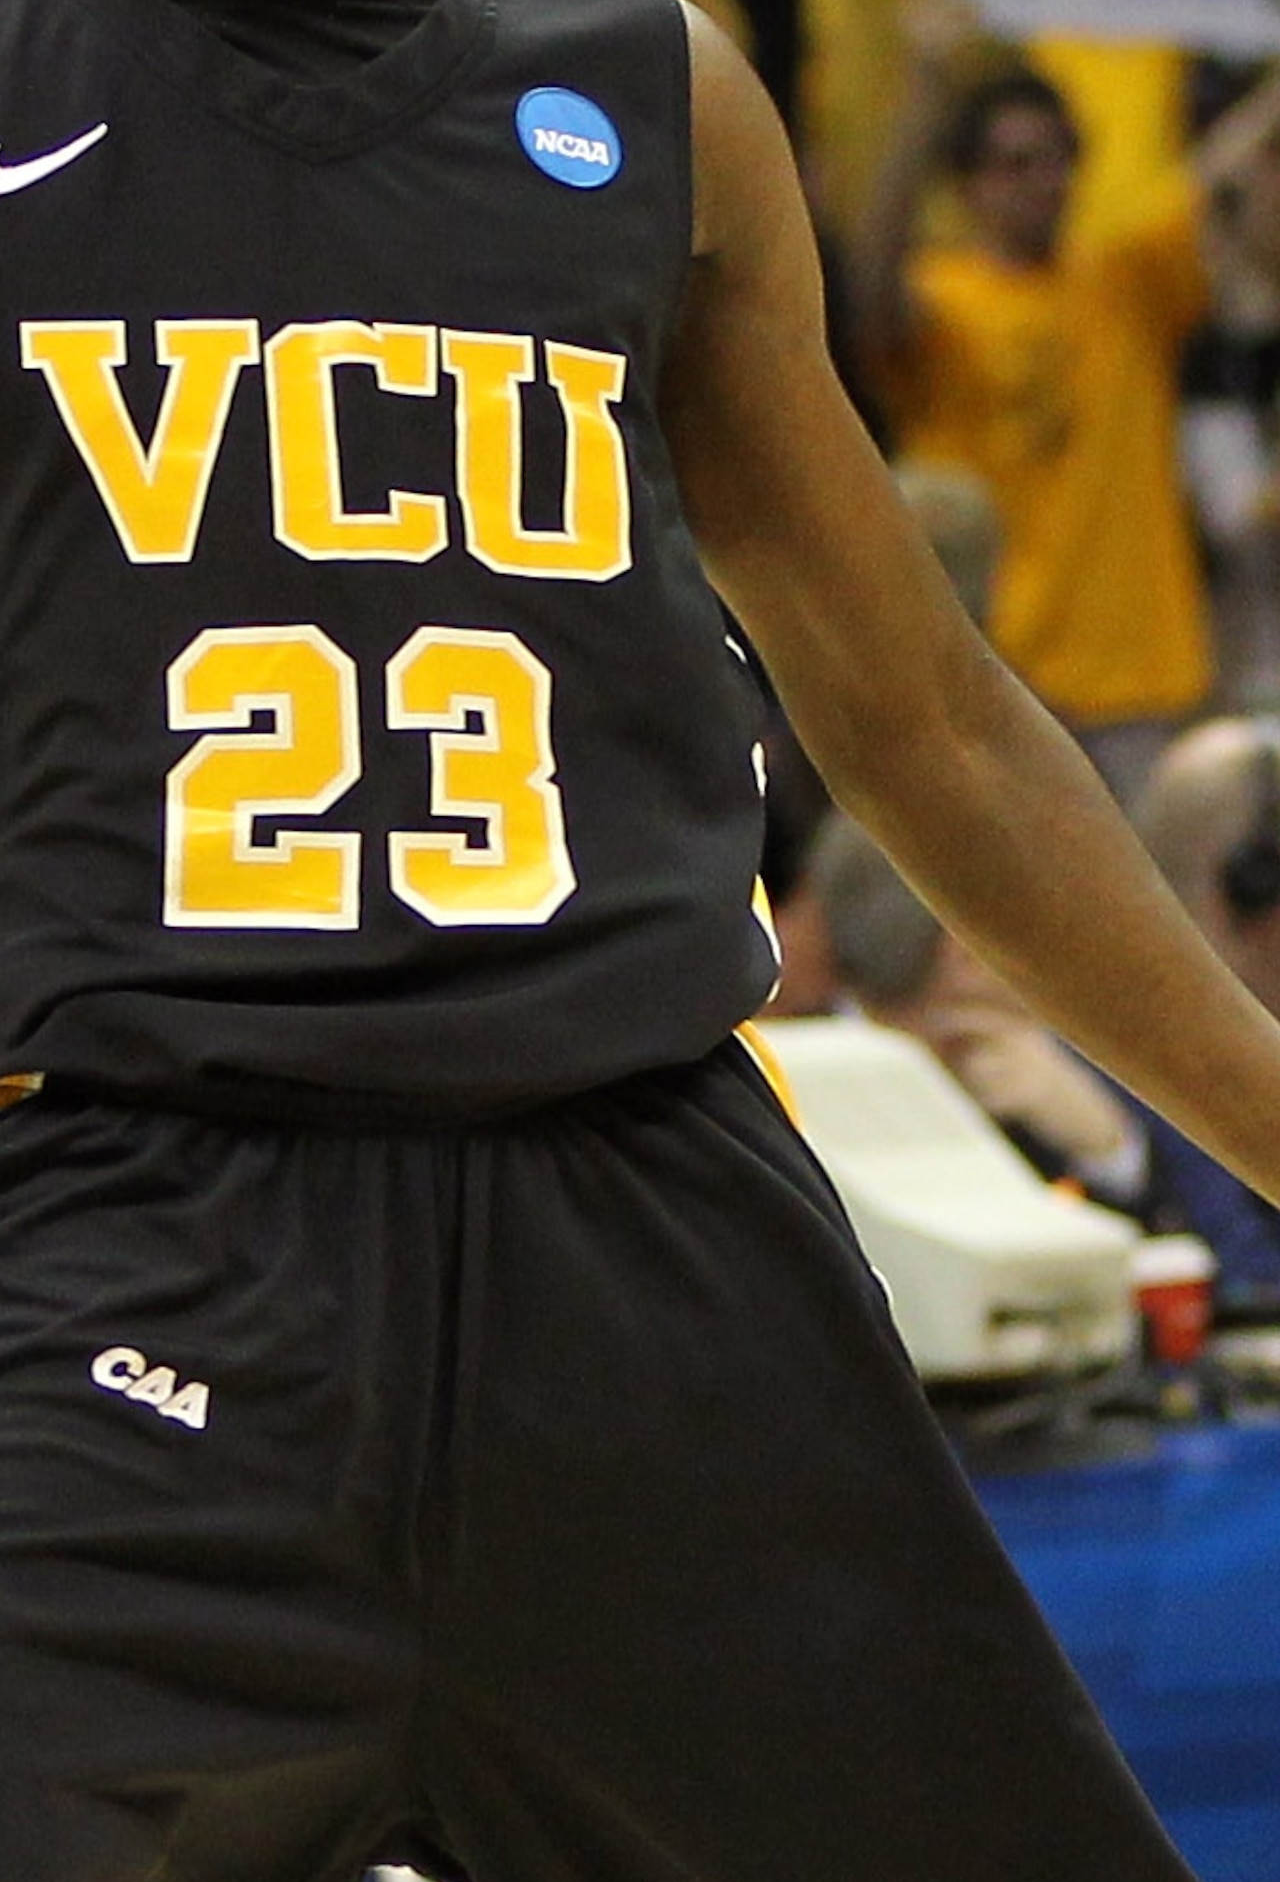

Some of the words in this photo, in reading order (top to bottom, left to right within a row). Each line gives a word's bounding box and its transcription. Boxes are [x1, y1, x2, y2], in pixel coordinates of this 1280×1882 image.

[532, 127, 610, 167] NCAA
[20, 318, 633, 582] VCU
[163, 624, 578, 931] 23
[90, 1345, 210, 1431] CAA
